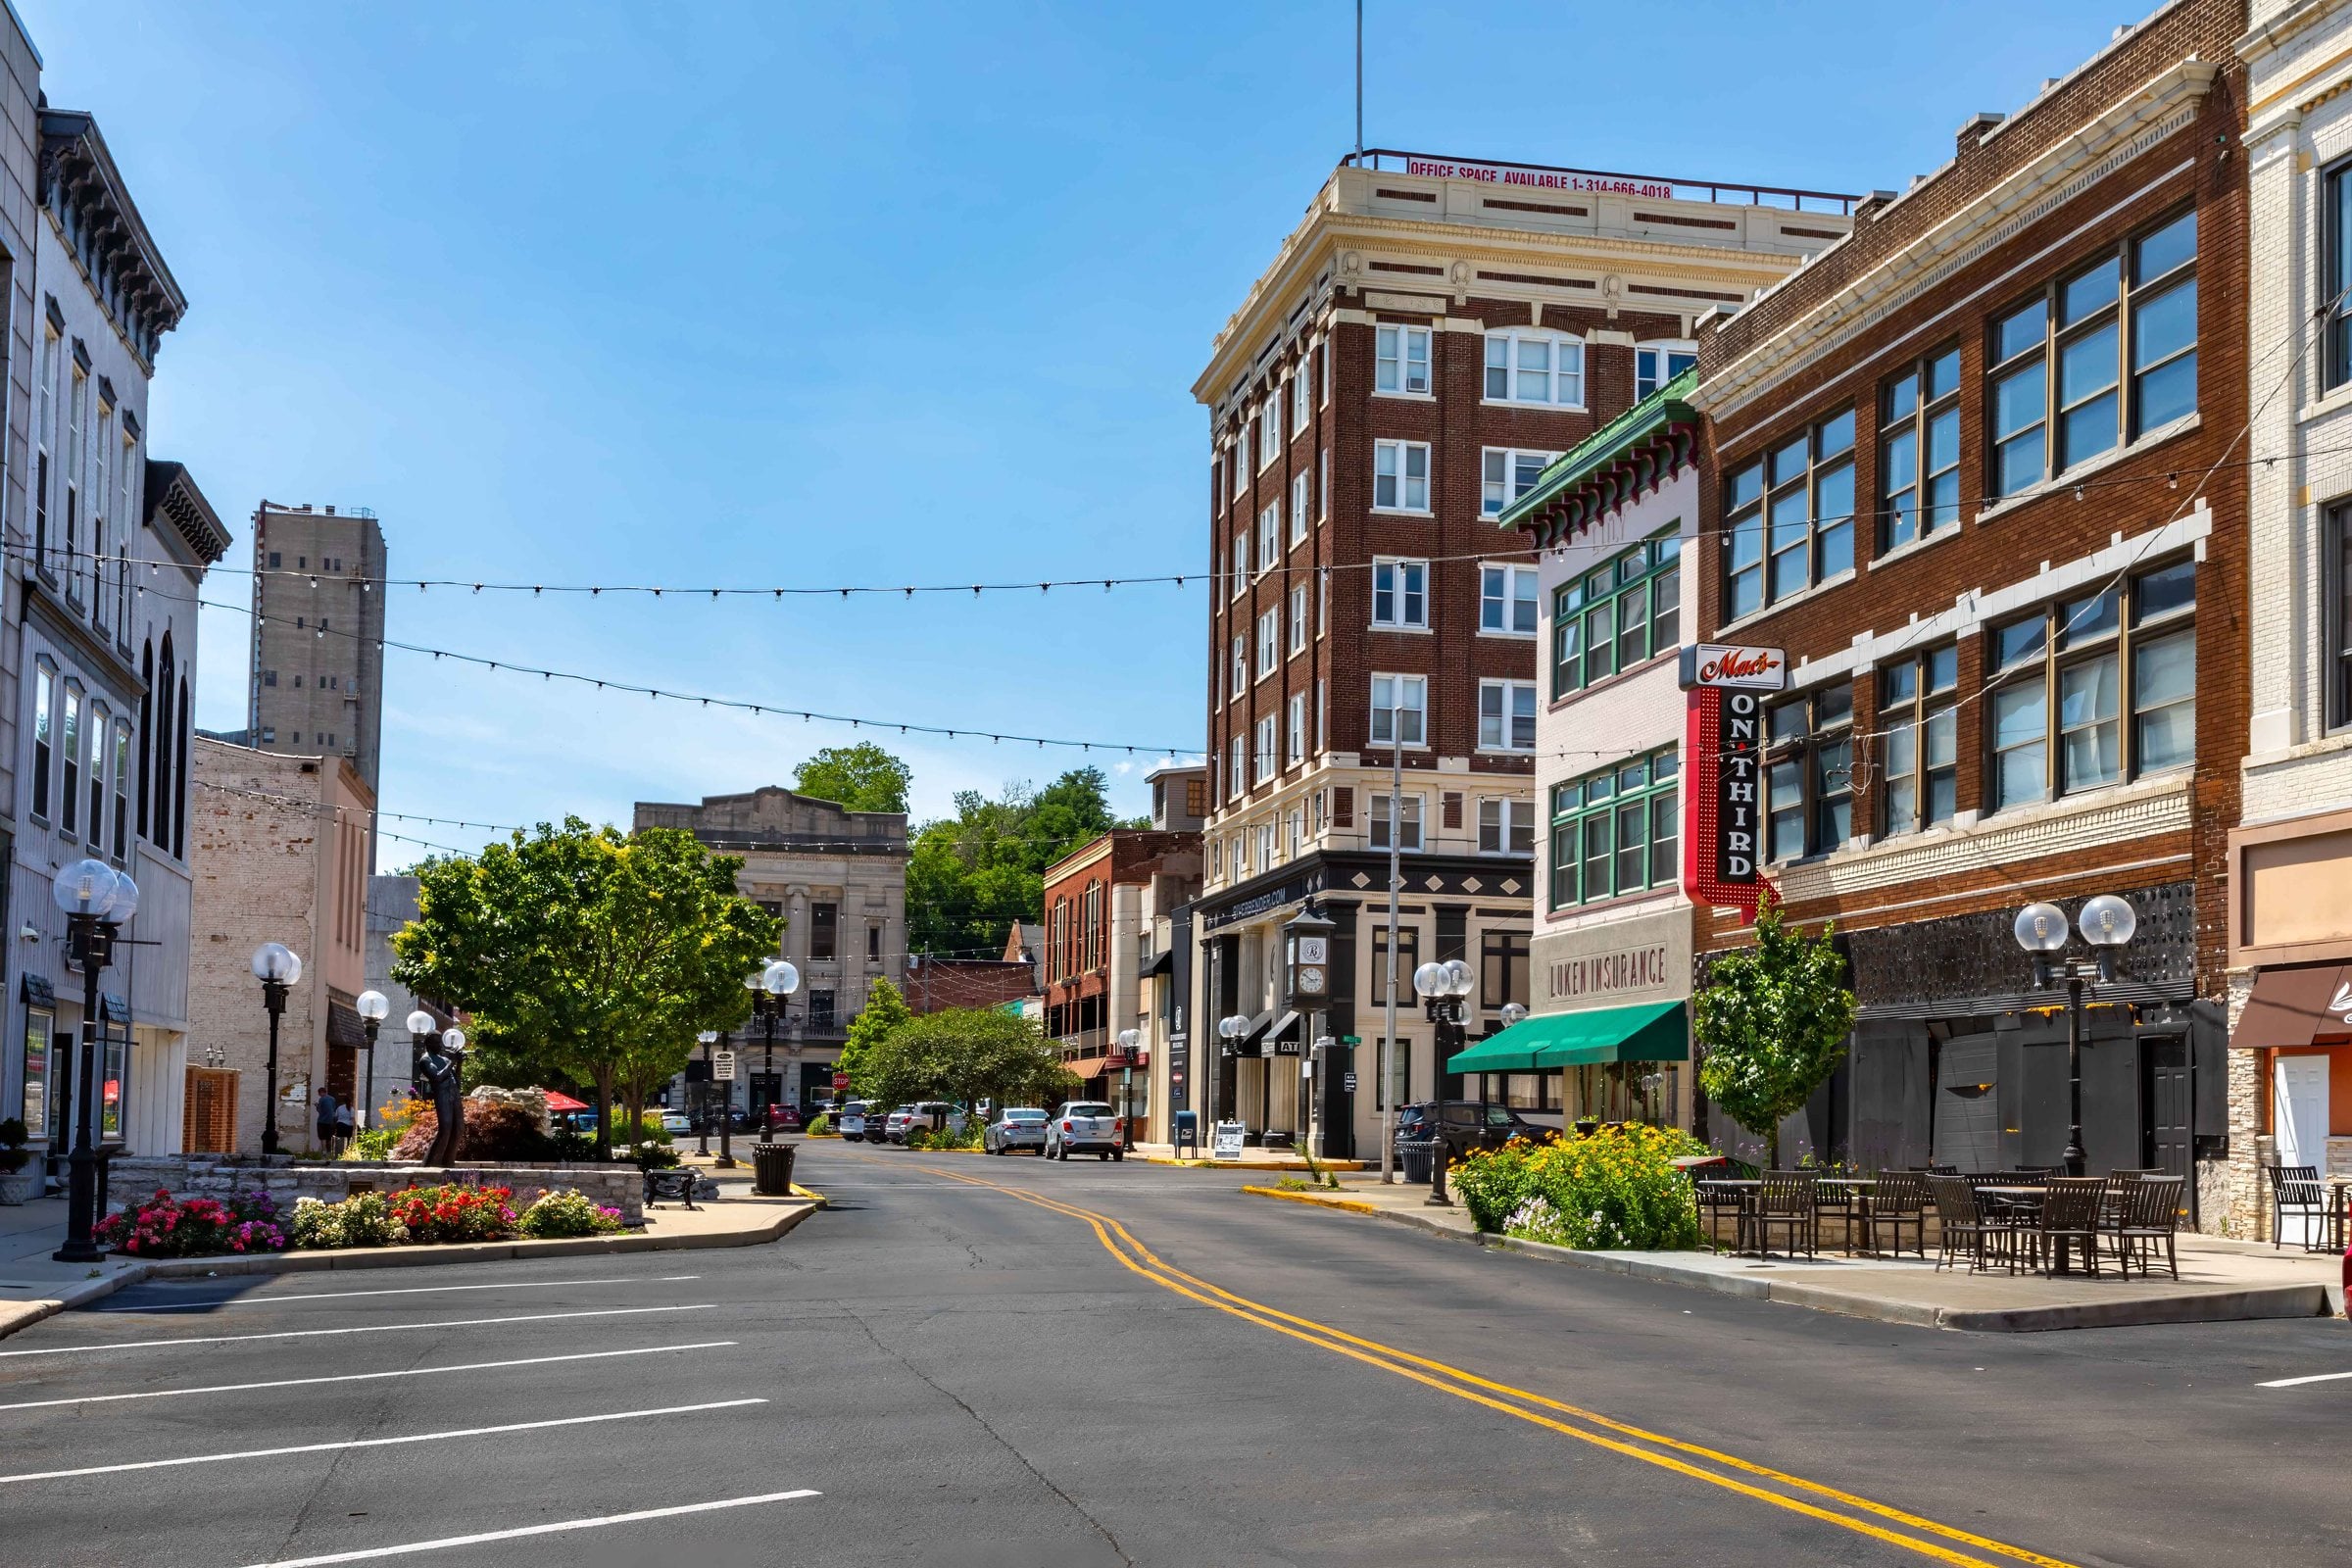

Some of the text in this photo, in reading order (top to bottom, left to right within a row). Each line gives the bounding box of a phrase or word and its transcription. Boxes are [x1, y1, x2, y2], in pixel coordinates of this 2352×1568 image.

[1410, 162, 1454, 177] OFFICE
[1458, 167, 1497, 182] SPACE
[1503, 172, 1567, 189] AVAILABLE
[1700, 649, 1781, 682] Mac's
[1728, 694, 1754, 876] ON THIRD
[1550, 947, 1665, 999] LUKEN INSURANCE
